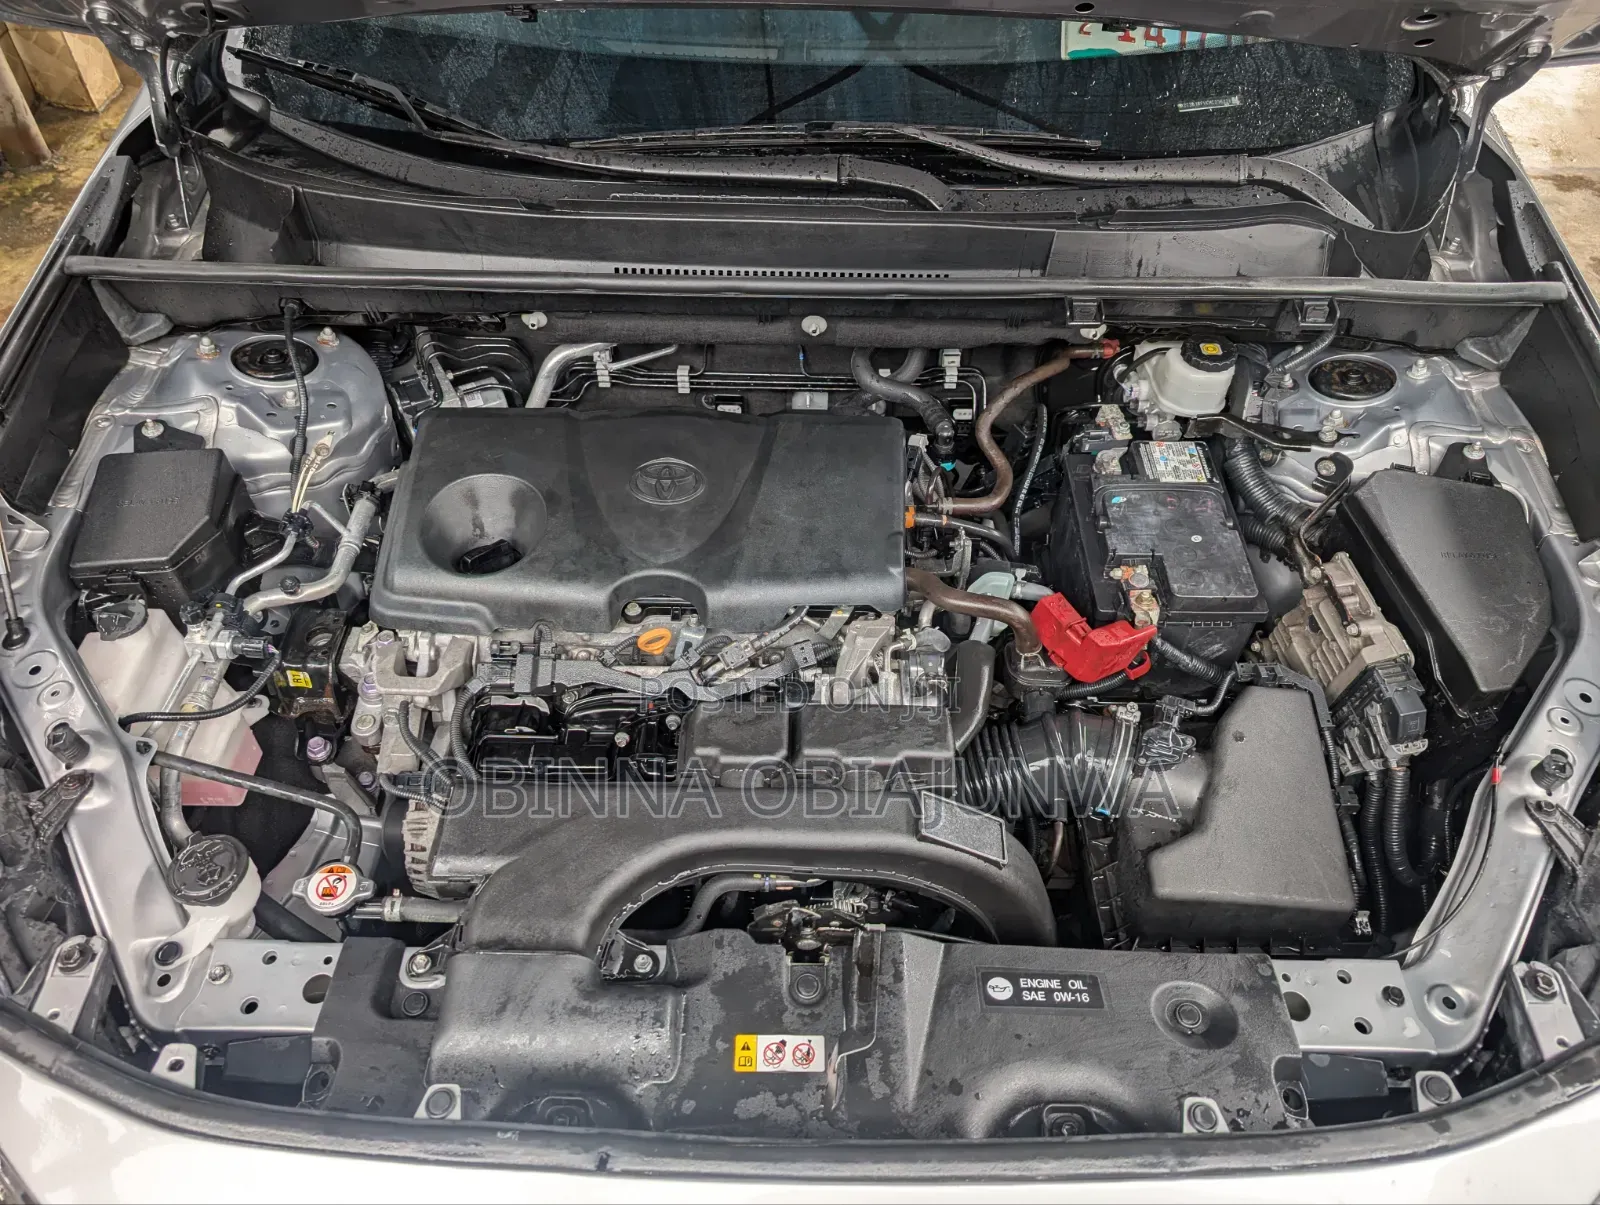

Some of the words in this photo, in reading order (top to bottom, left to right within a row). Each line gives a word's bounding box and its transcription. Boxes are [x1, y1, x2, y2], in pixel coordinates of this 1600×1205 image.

[1020, 978, 1061, 989] ENGINE
[1068, 980, 1088, 990] OIL
[1022, 990, 1047, 1001] SAE
[1053, 991, 1090, 1003] 0W-16
